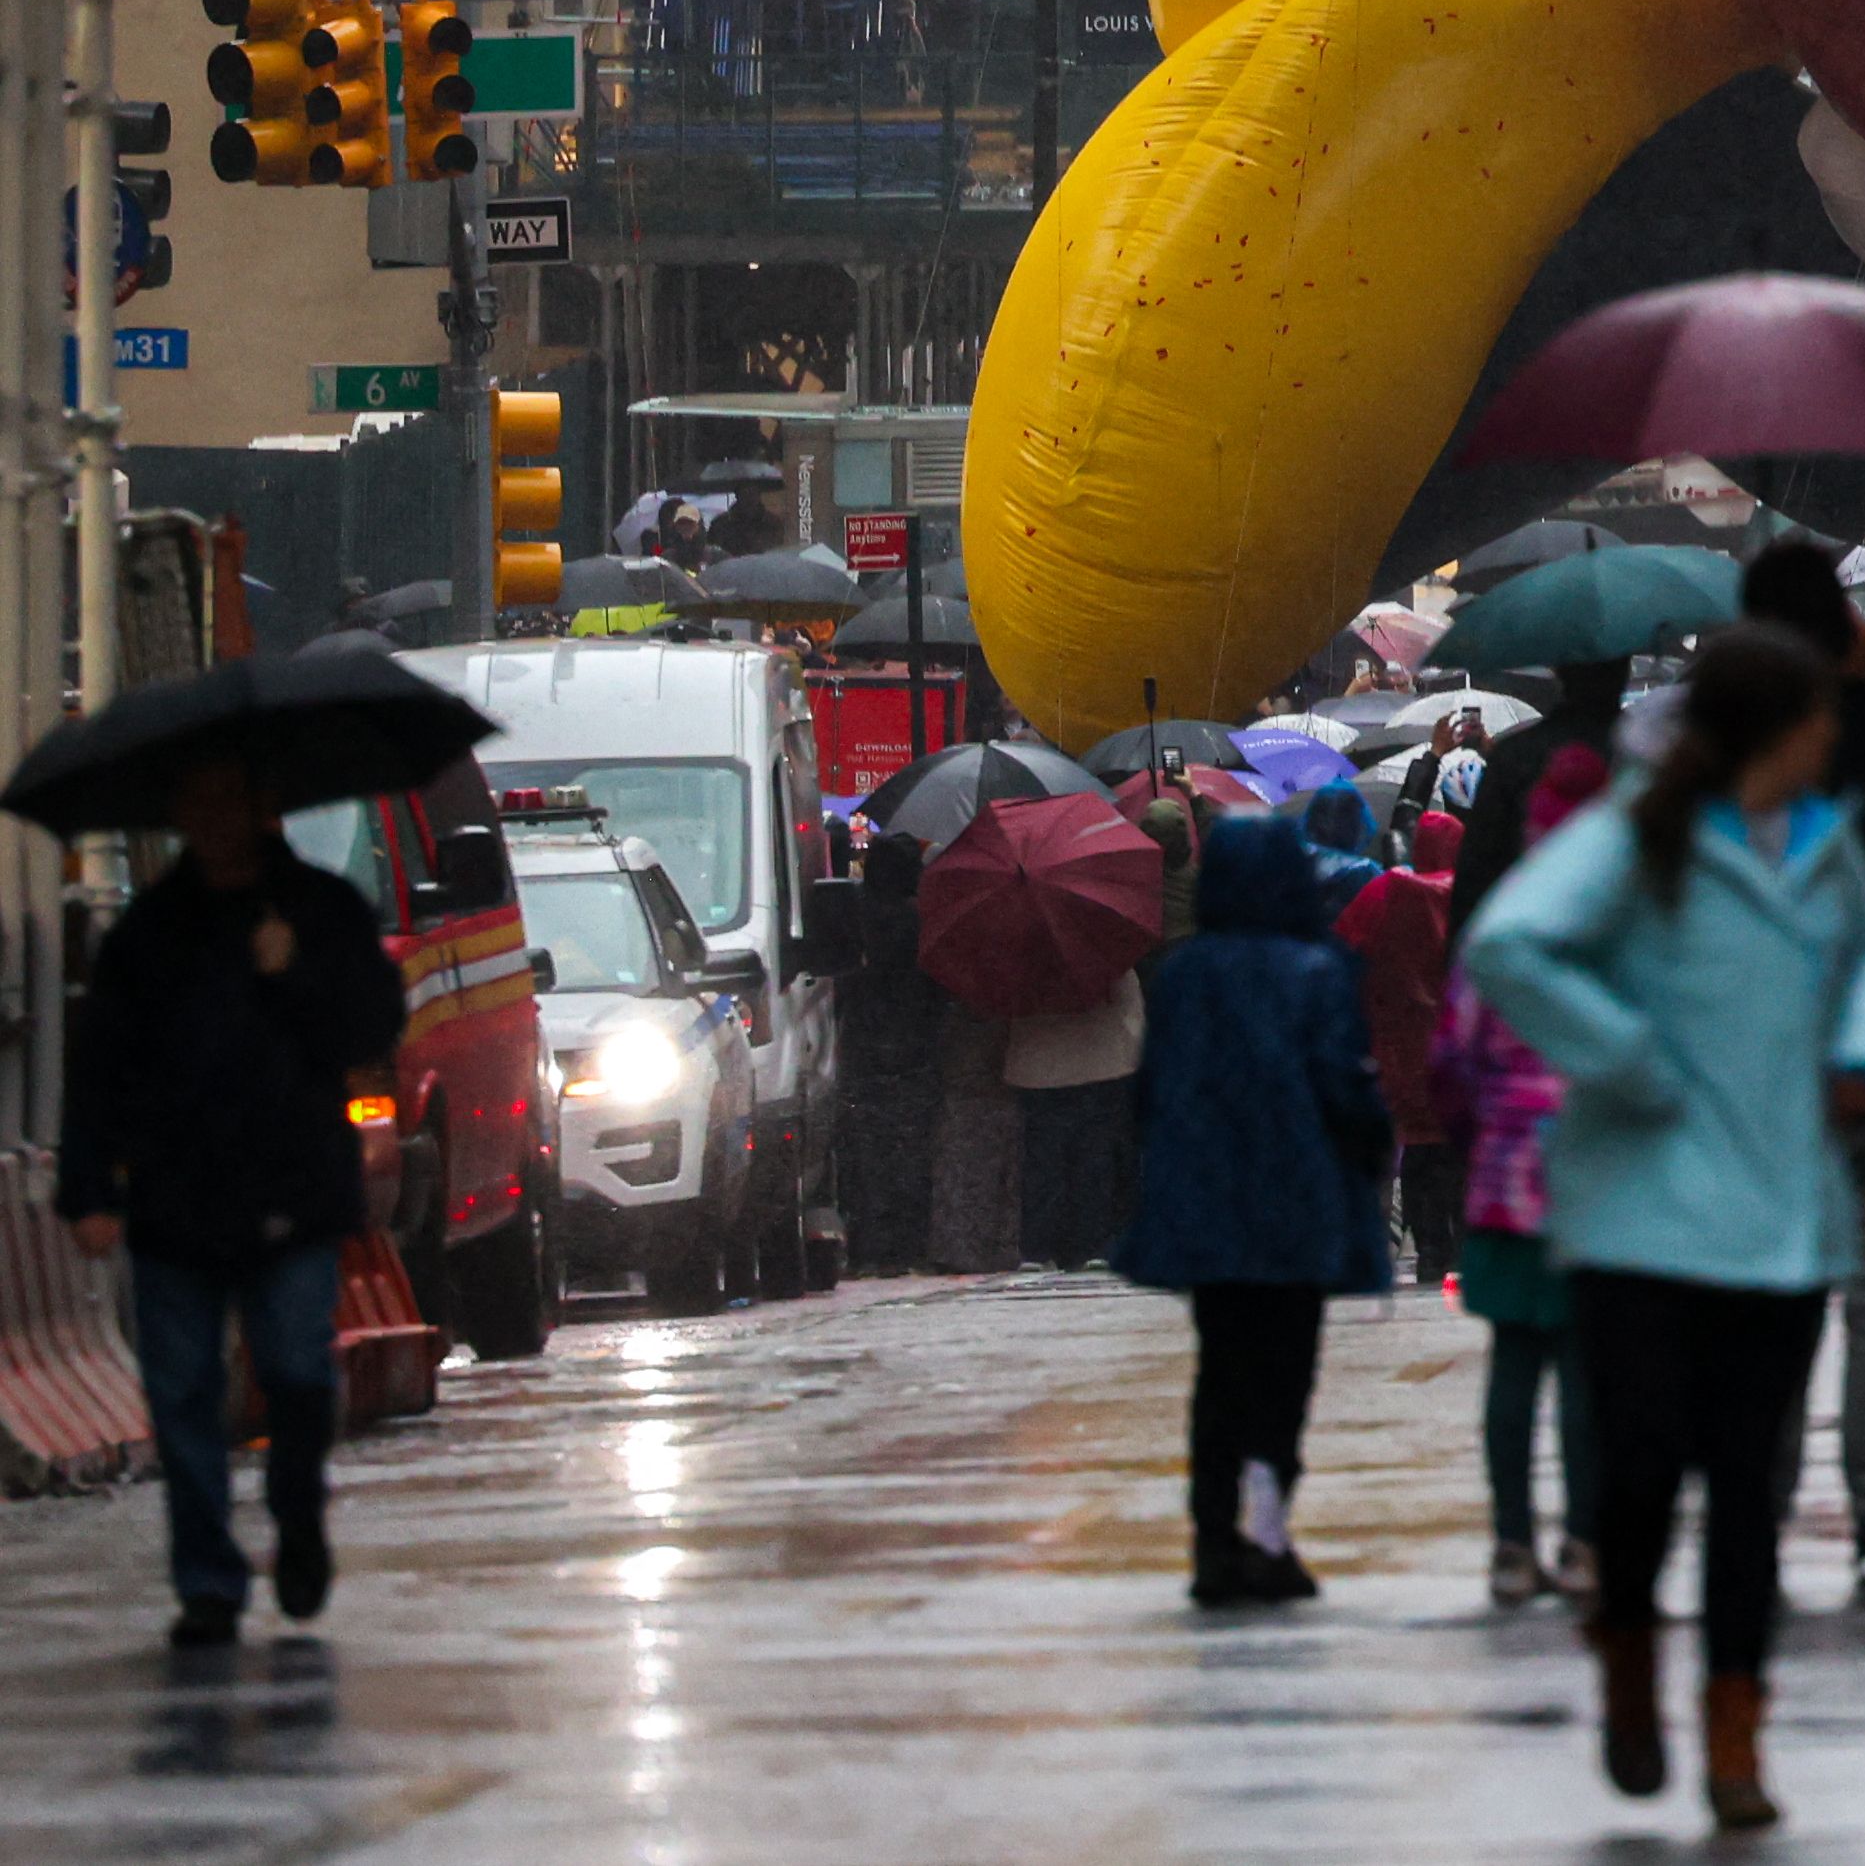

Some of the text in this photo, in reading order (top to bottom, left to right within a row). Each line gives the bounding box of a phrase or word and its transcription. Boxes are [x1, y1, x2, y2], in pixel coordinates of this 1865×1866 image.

[1085, 15, 1139, 32] LOUIS
[490, 220, 546, 245] WAY
[116, 335, 170, 364] M31
[366, 370, 421, 406] 6 AV
[849, 521, 862, 532] NO
